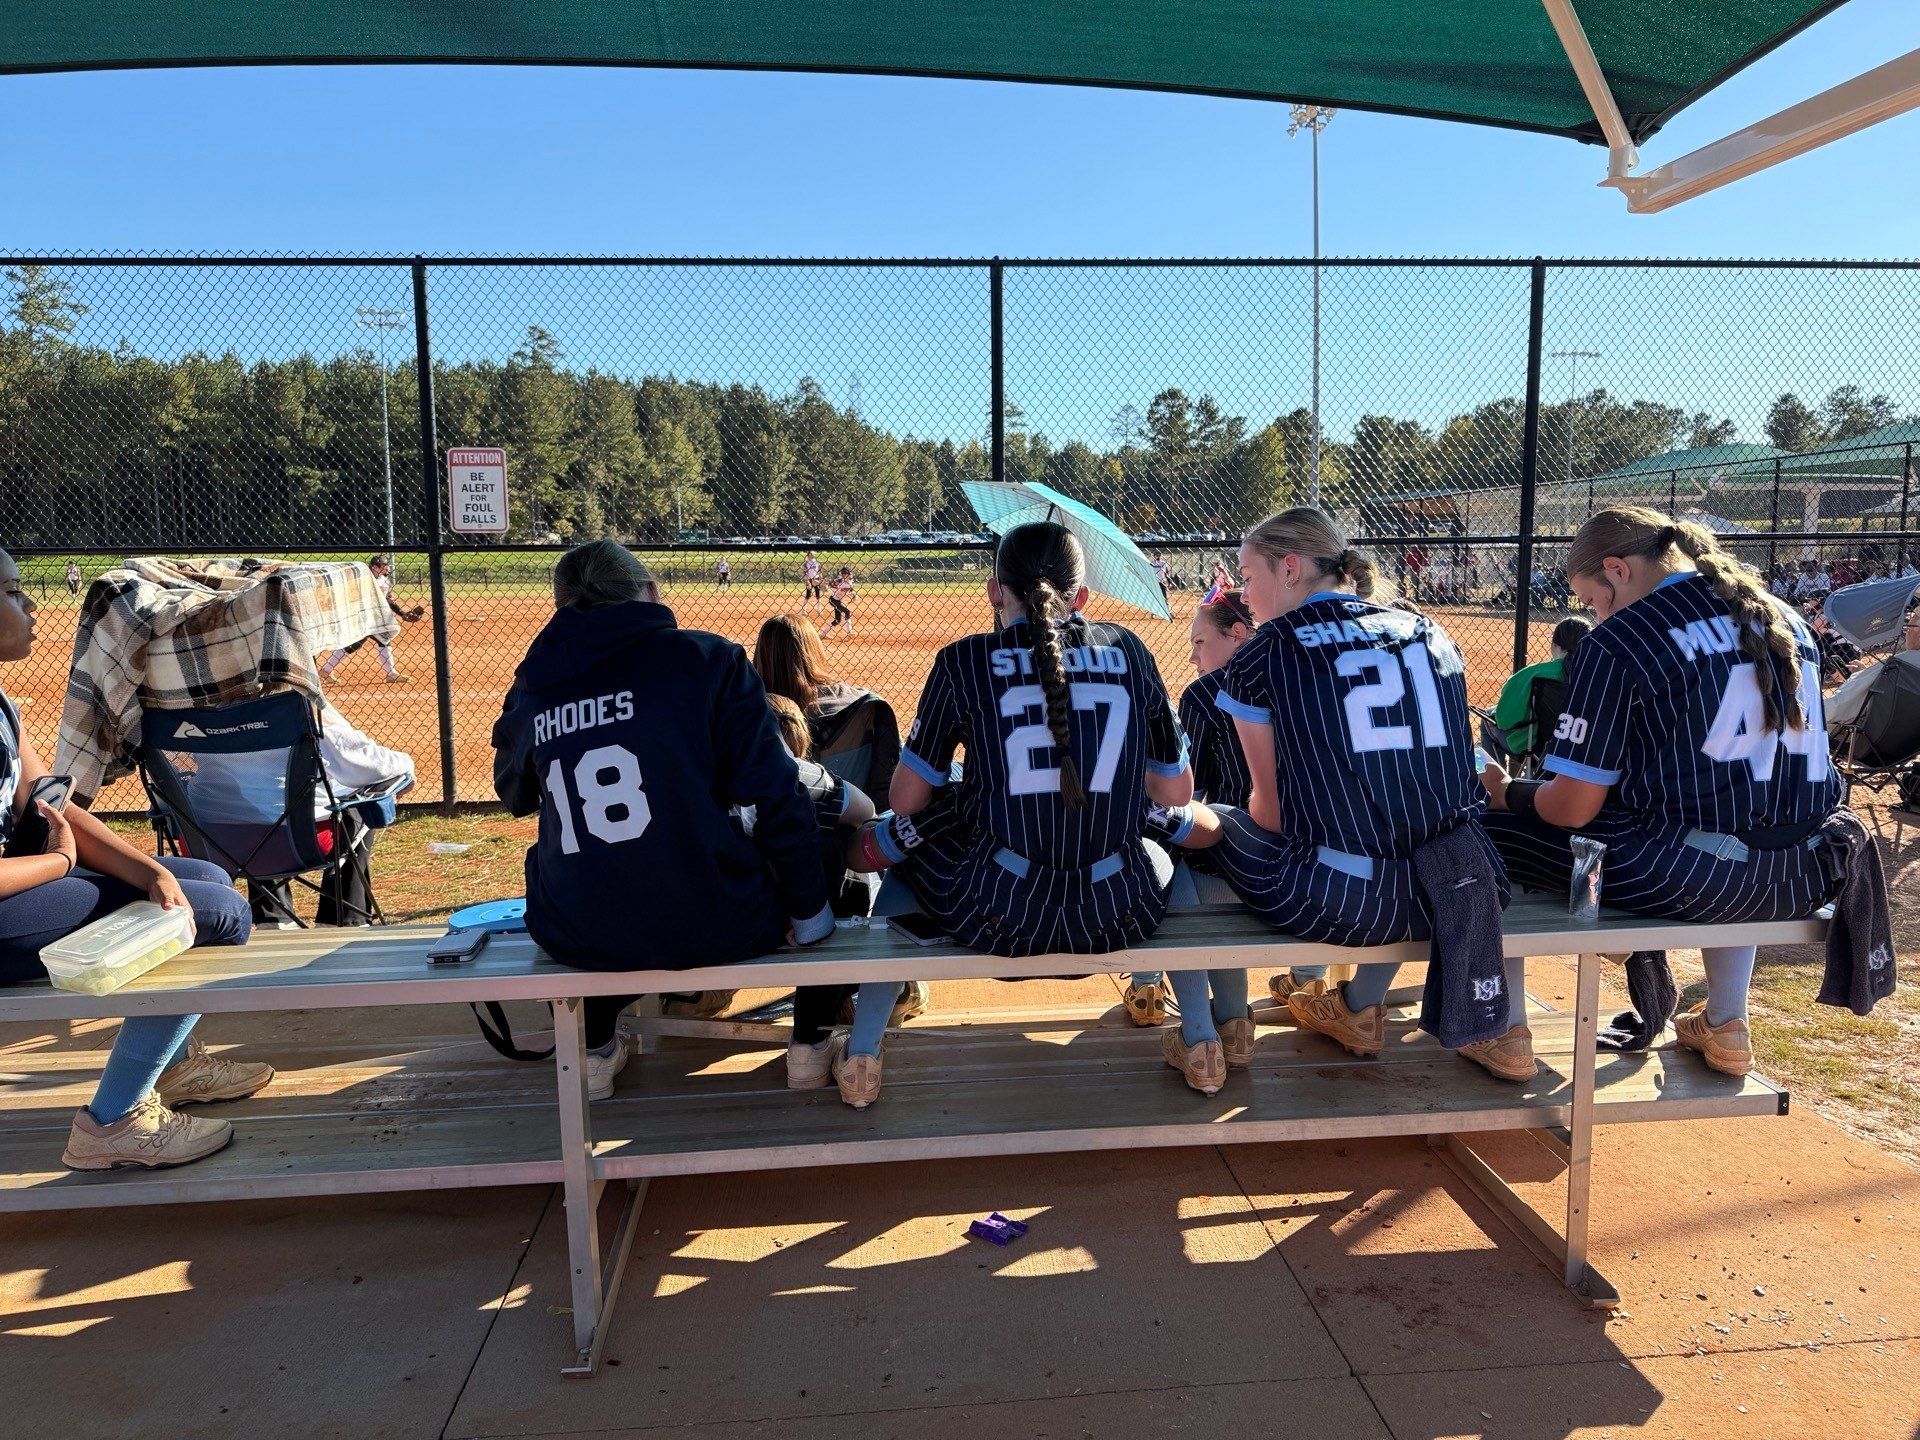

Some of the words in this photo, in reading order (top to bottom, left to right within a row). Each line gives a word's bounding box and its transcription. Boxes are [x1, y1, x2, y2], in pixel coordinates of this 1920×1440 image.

[452, 452, 501, 464] ATTENTION
[461, 483, 495, 493] ALERT
[470, 472, 485, 482] BE
[465, 503, 493, 513] FOUL
[470, 494, 487, 502] FOR
[462, 514, 497, 524] BALLS
[991, 645, 1128, 677] STOUD
[1334, 642, 1448, 753] 21
[534, 690, 634, 747] RHODES
[1553, 712, 1589, 745] 30
[1701, 662, 1830, 782] 44
[1000, 682, 1131, 796] 27
[546, 744, 652, 855] 18
